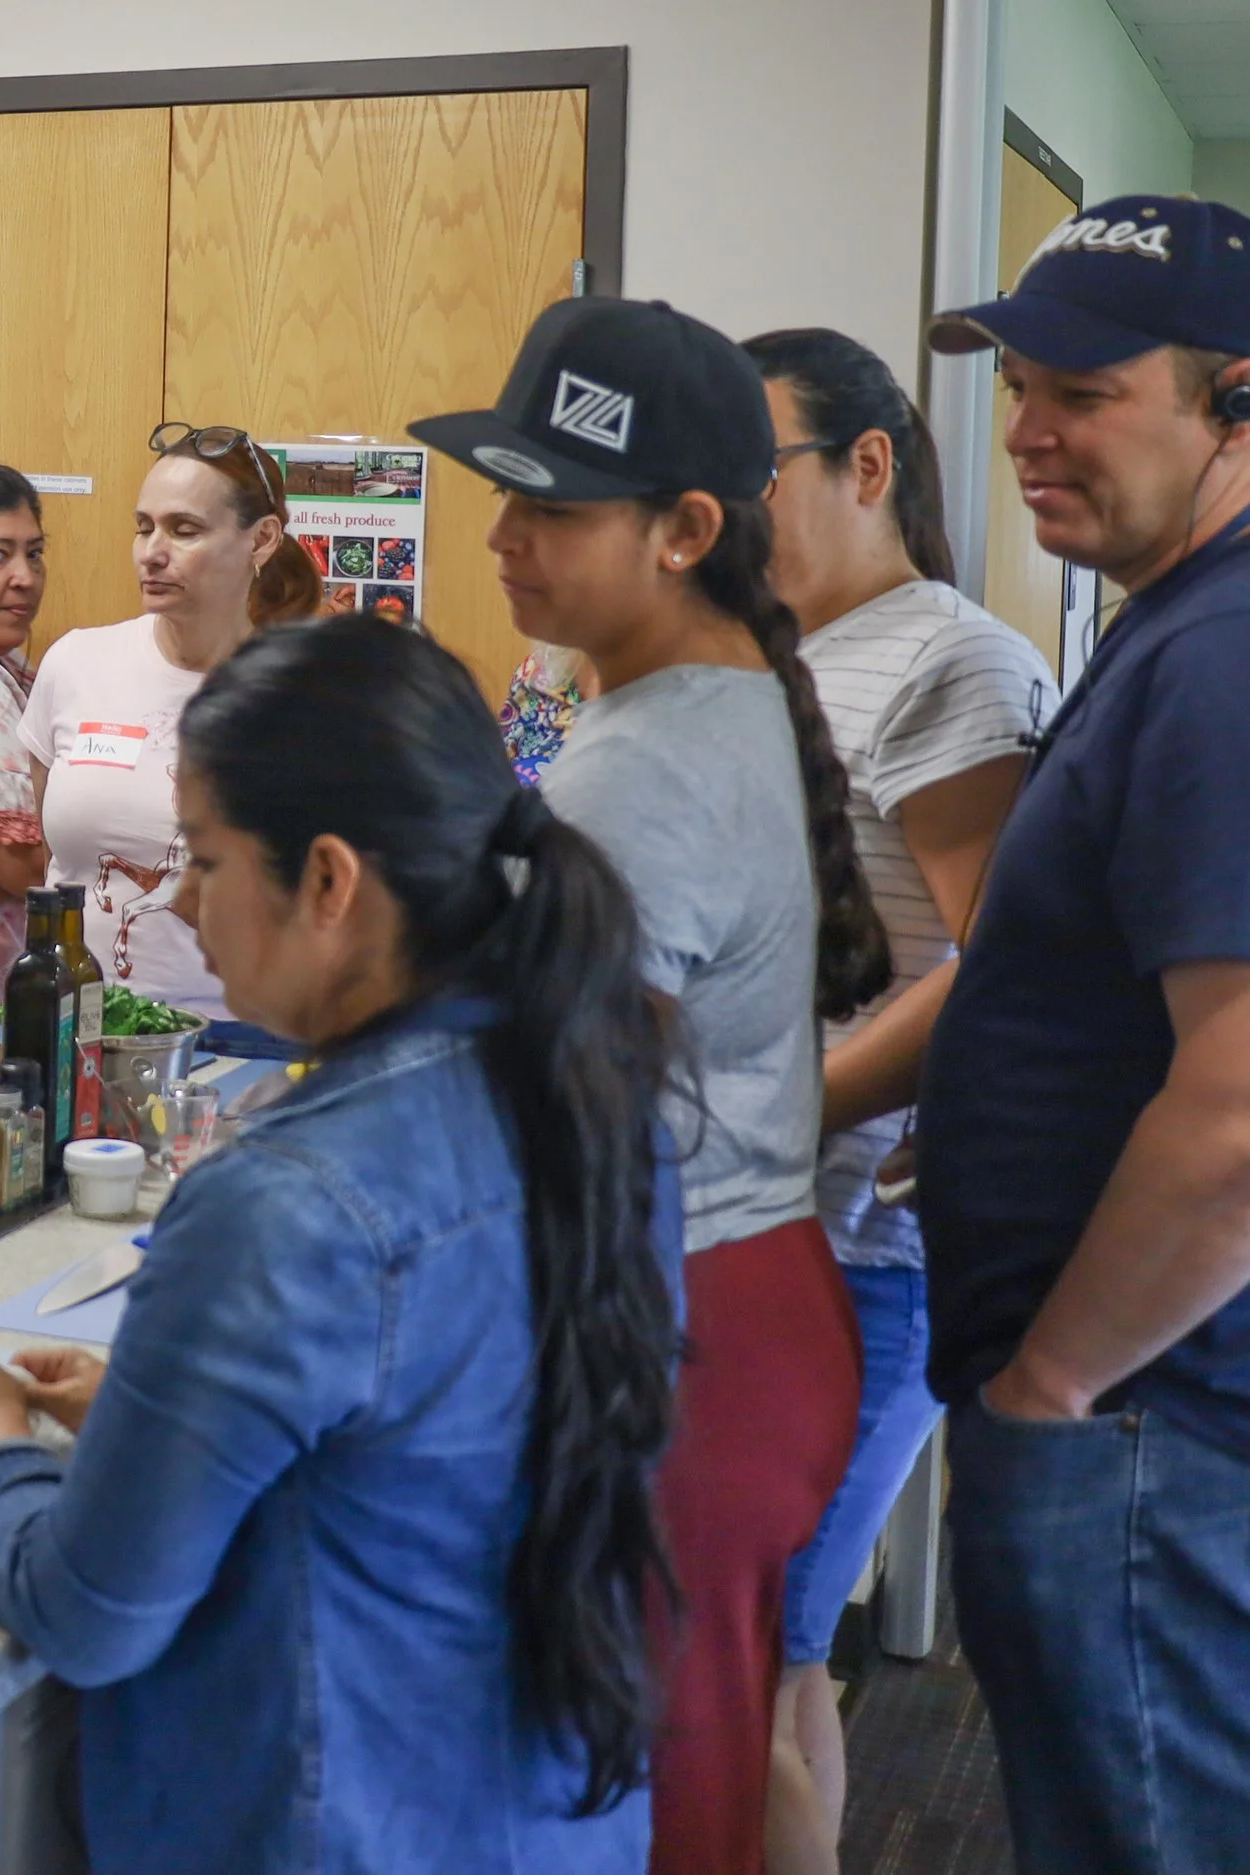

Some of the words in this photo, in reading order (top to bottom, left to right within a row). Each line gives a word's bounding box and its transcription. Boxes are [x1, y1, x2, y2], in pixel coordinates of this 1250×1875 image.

[294, 511, 308, 524] all
[311, 511, 341, 525] fresh
[345, 513, 396, 528] produce
